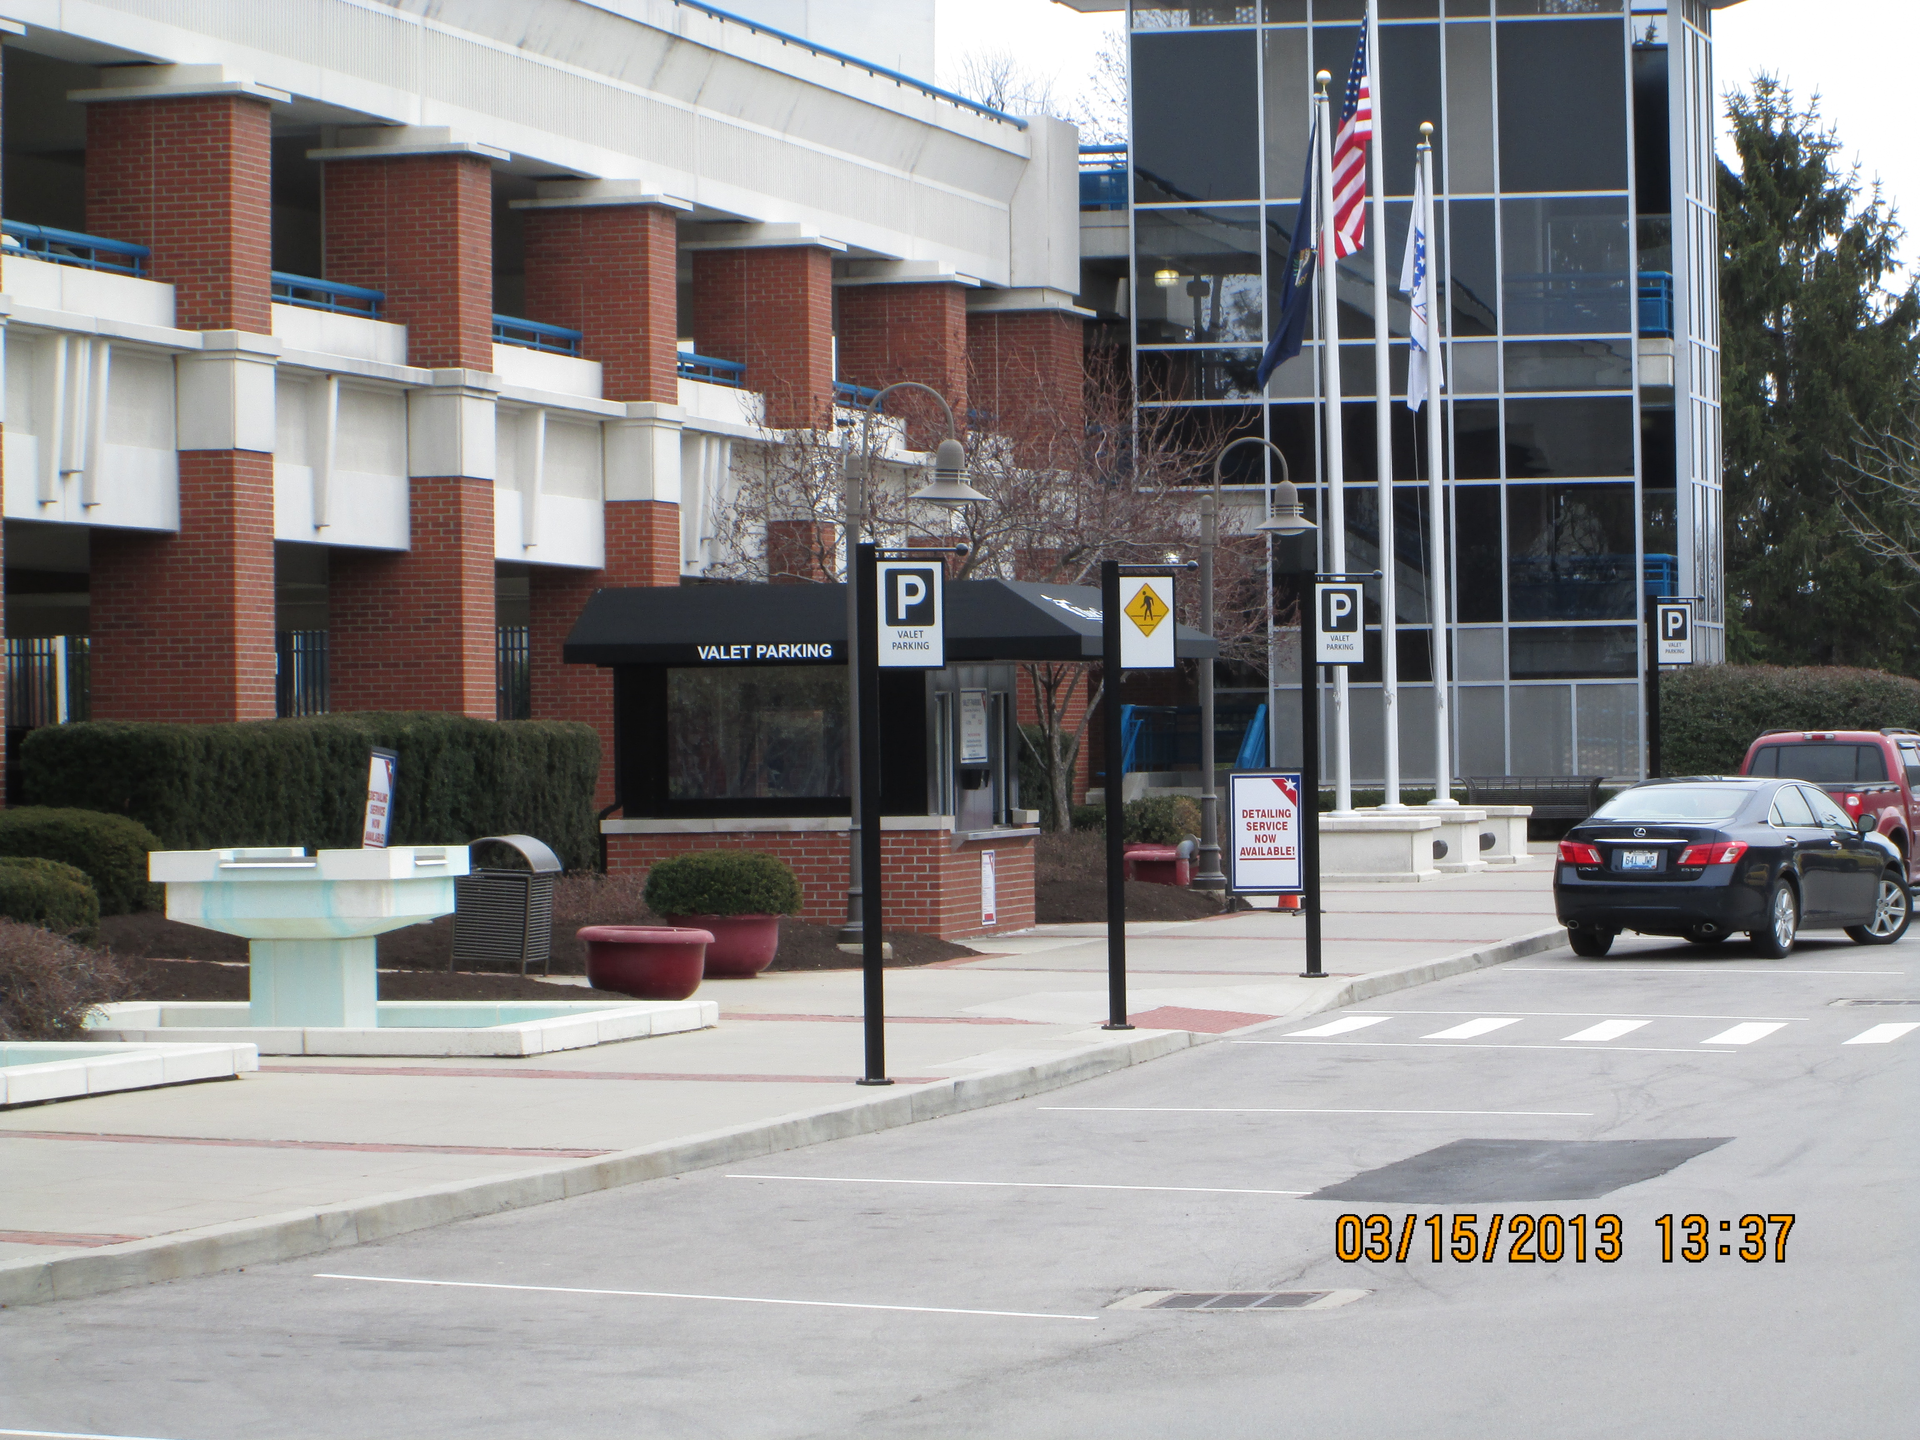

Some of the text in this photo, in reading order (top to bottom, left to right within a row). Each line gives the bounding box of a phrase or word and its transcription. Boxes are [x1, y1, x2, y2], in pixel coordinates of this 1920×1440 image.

[897, 574, 926, 620] P
[1330, 592, 1352, 628] P
[1667, 611, 1683, 637] P
[897, 630, 924, 639] VALET
[892, 641, 930, 650] PARKING
[1326, 643, 1354, 651] PARKING
[697, 643, 833, 660] VALET PARKING
[1242, 809, 1292, 819] DETAILING
[1246, 821, 1288, 831] SERVICE
[1254, 834, 1277, 844] NOW
[1240, 846, 1296, 856] AVAILABLE!
[1625, 855, 1637, 865] 641
